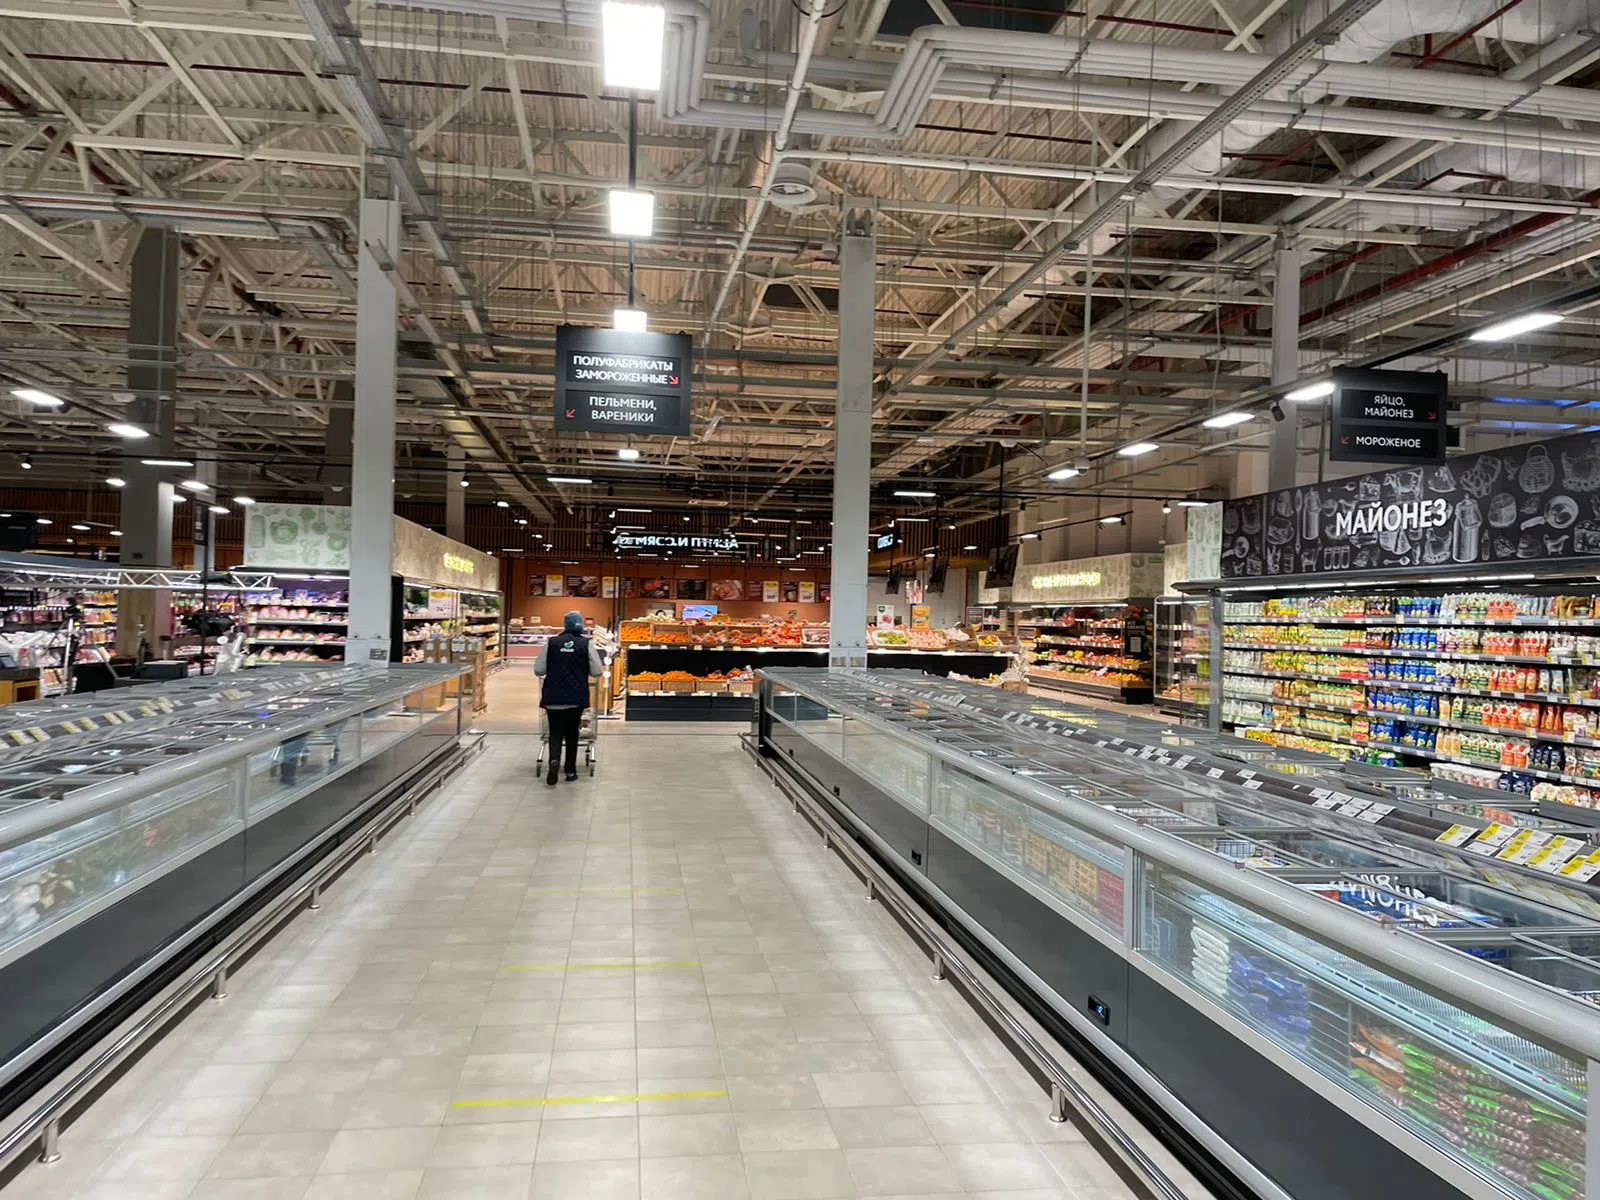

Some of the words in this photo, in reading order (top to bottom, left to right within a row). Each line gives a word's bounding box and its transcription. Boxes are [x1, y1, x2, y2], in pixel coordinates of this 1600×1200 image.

[573, 355, 673, 371] ПОЛУФАБРИКАТЫ
[575, 369, 668, 384] ЗАМОРОЖЕННЫЕ
[1374, 394, 1406, 407] ЯЙЦО,
[591, 410, 654, 422] ВАРЕНИКИ
[1364, 406, 1414, 419] МАЙОНЕЗ
[1355, 436, 1421, 448] МОРОЖЕНОЕ
[1335, 498, 1447, 537] МАЙОНЕЗ
